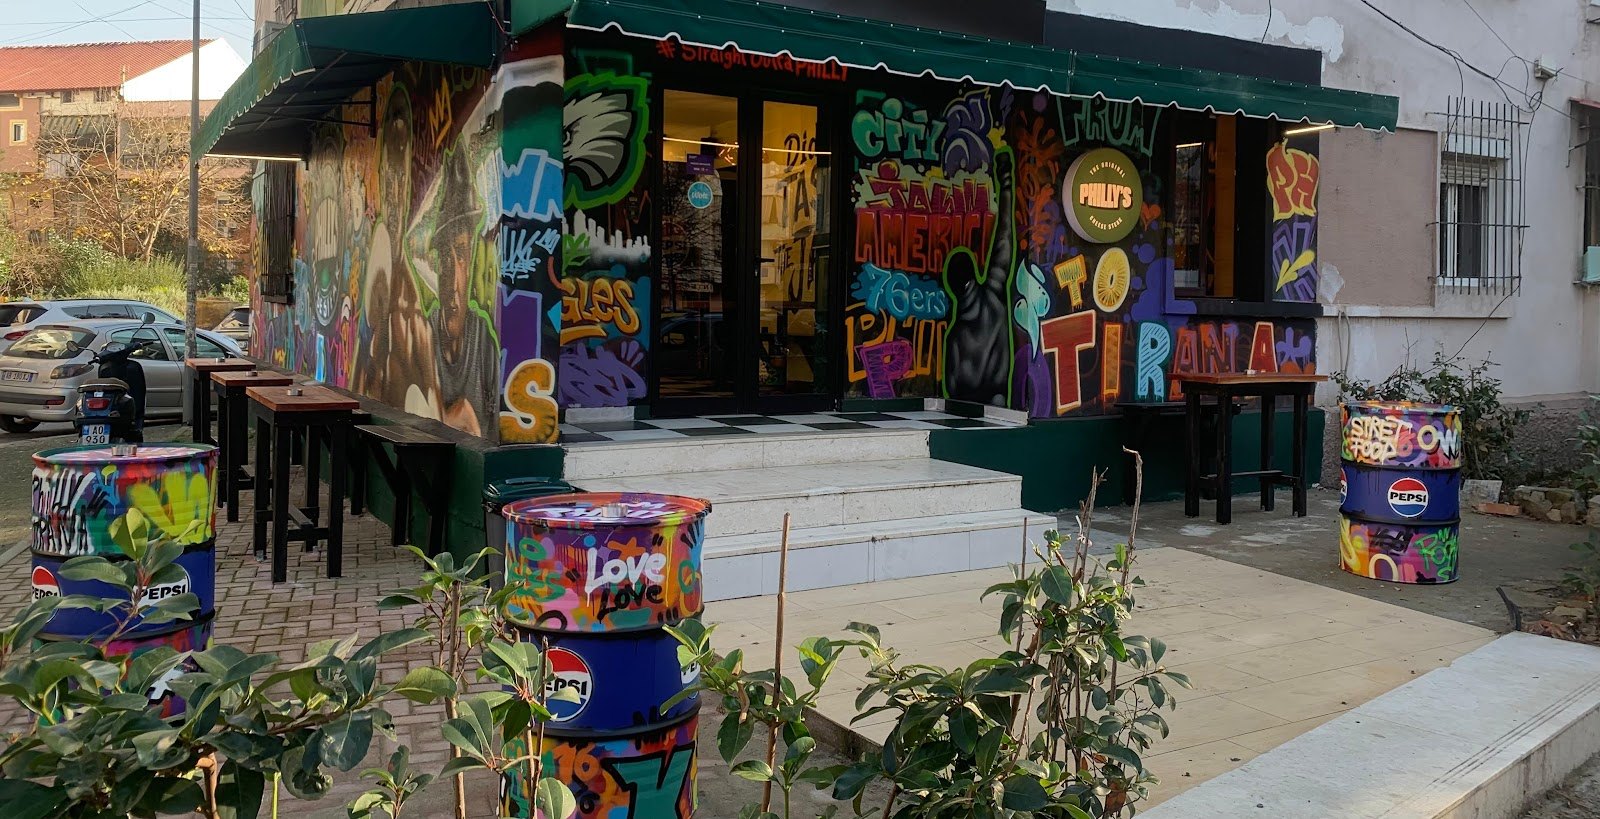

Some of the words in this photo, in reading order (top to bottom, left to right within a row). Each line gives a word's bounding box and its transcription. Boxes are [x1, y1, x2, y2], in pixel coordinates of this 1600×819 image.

[1079, 182, 1132, 209] PHILLY'S
[1089, 215, 1107, 231] CHEESE
[1053, 247, 1131, 312] TO
[1040, 309, 1279, 415] TIRANA
[1390, 492, 1427, 503] PEPSI
